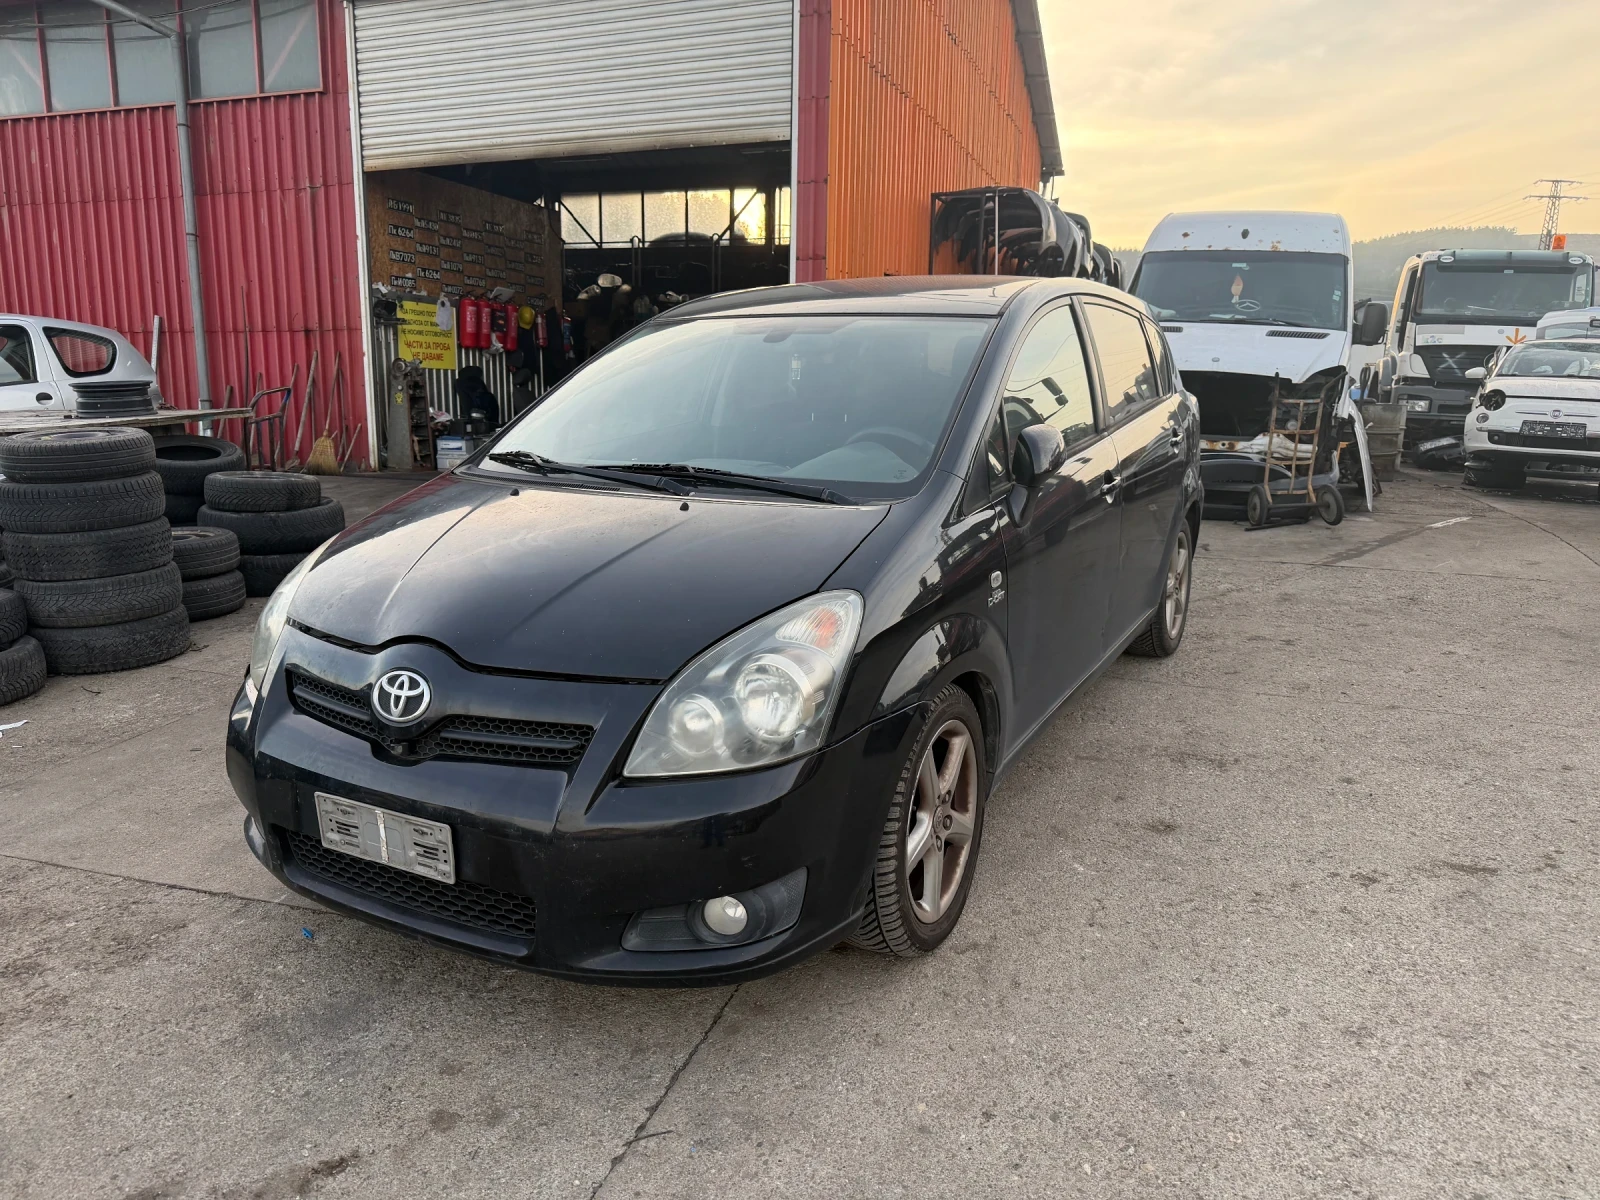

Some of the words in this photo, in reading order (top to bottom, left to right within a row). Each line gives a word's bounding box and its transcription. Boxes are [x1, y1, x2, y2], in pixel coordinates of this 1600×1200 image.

[397, 227, 414, 239] 6264
[425, 270, 440, 280] 6264
[403, 340, 424, 350] ЧАСТИ
[424, 341, 432, 350] ЗА
[432, 342, 451, 351] ПРОБА
[421, 352, 444, 362] ДАВАМЕ
